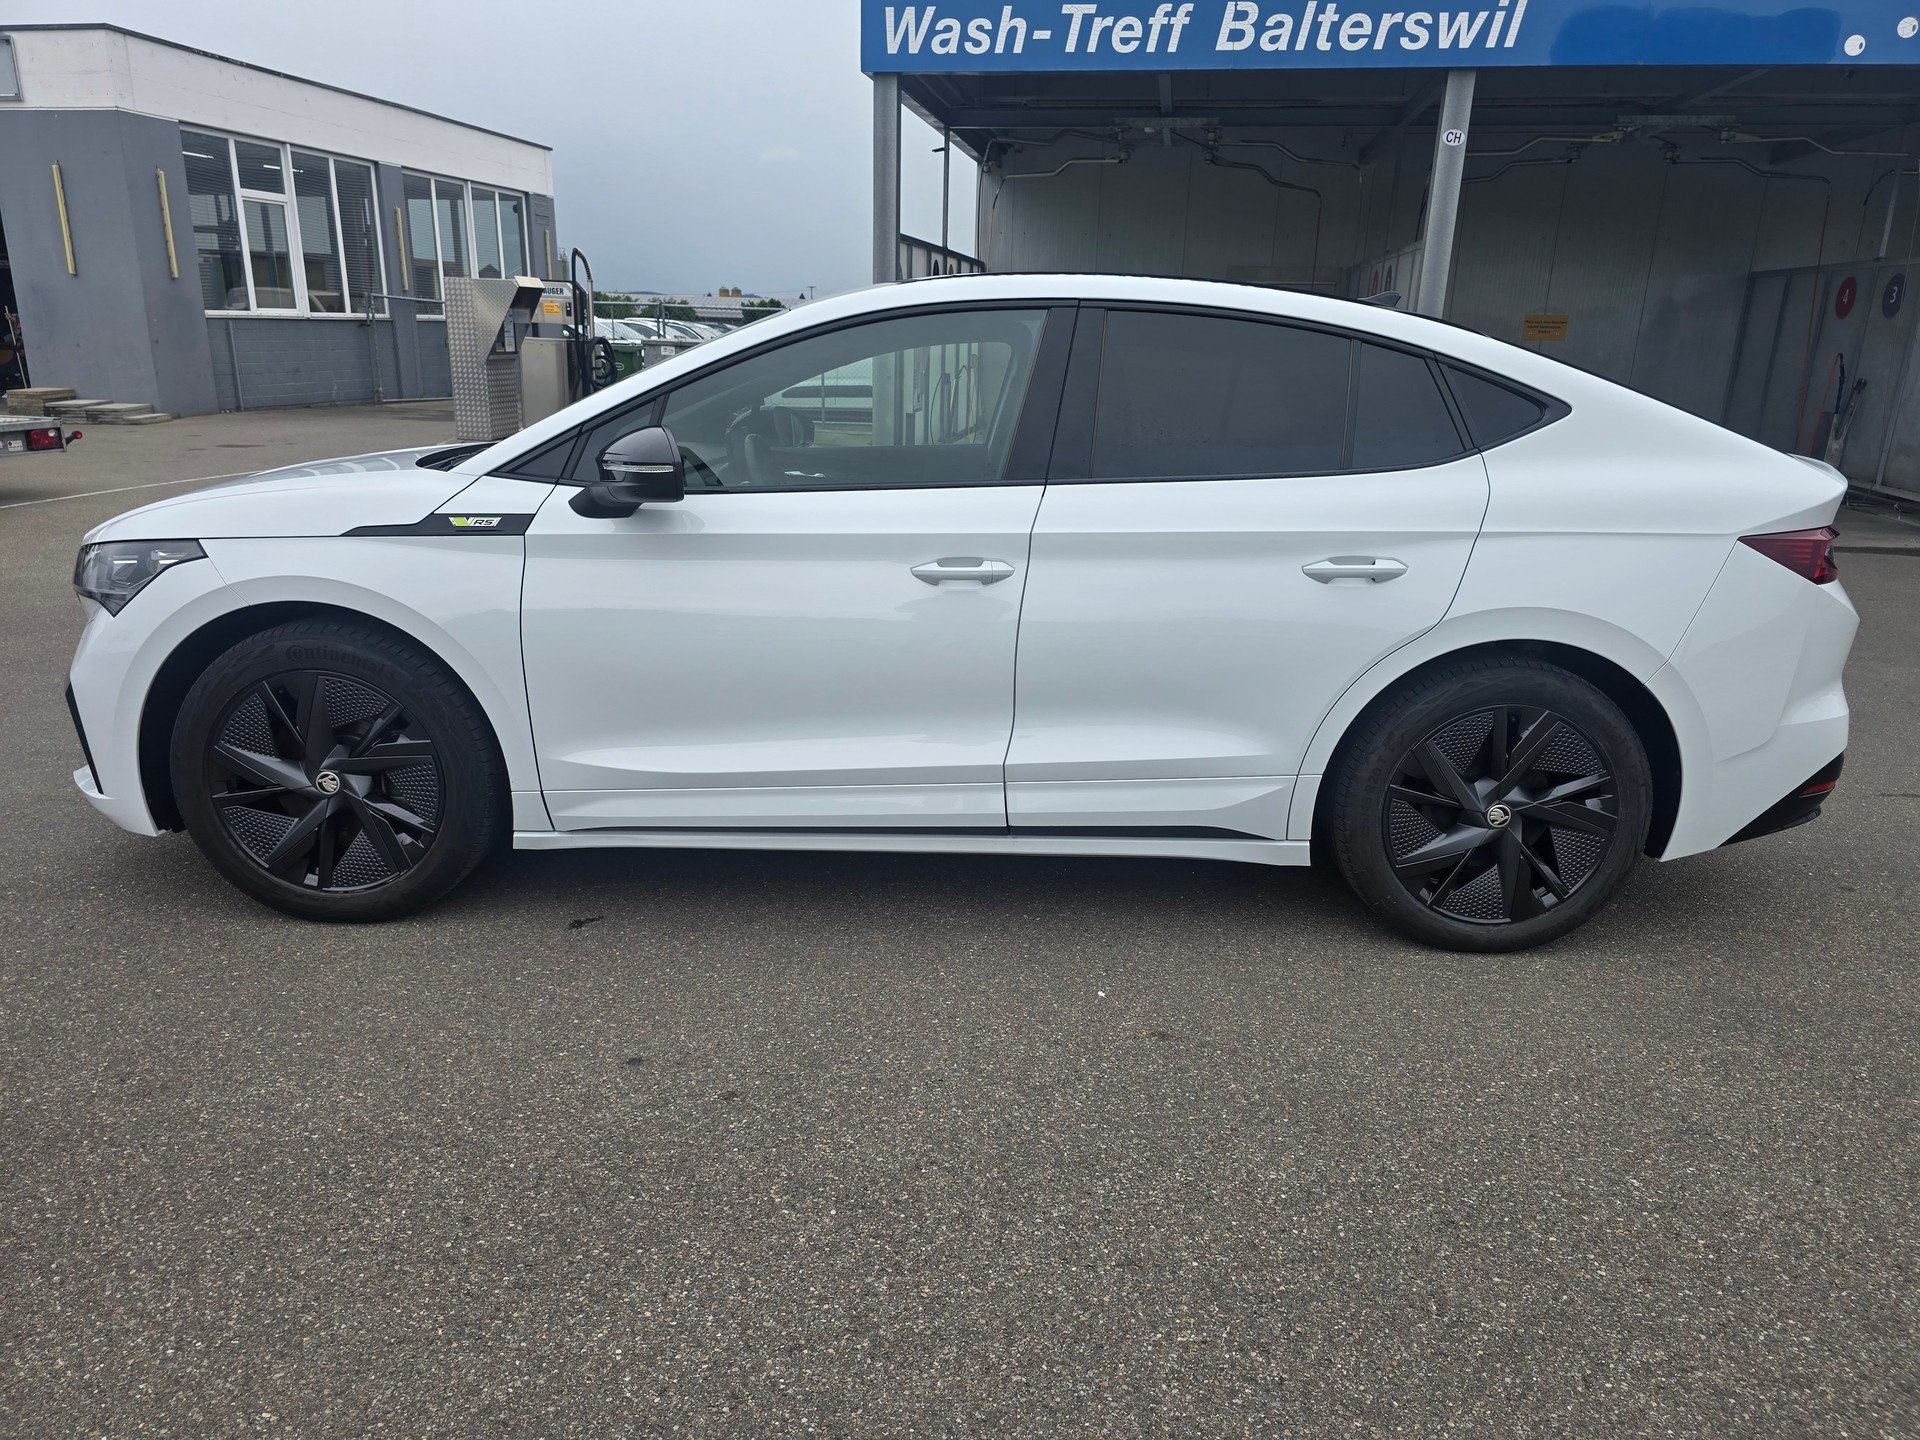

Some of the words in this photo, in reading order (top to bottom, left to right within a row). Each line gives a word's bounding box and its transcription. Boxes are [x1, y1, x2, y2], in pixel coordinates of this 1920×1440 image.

[884, 3, 1195, 54] Wash-Treff
[1215, 0, 1528, 51] Balterswil
[1445, 131, 1462, 143] CH
[1842, 288, 1850, 305] 4
[1889, 285, 1899, 304] 3
